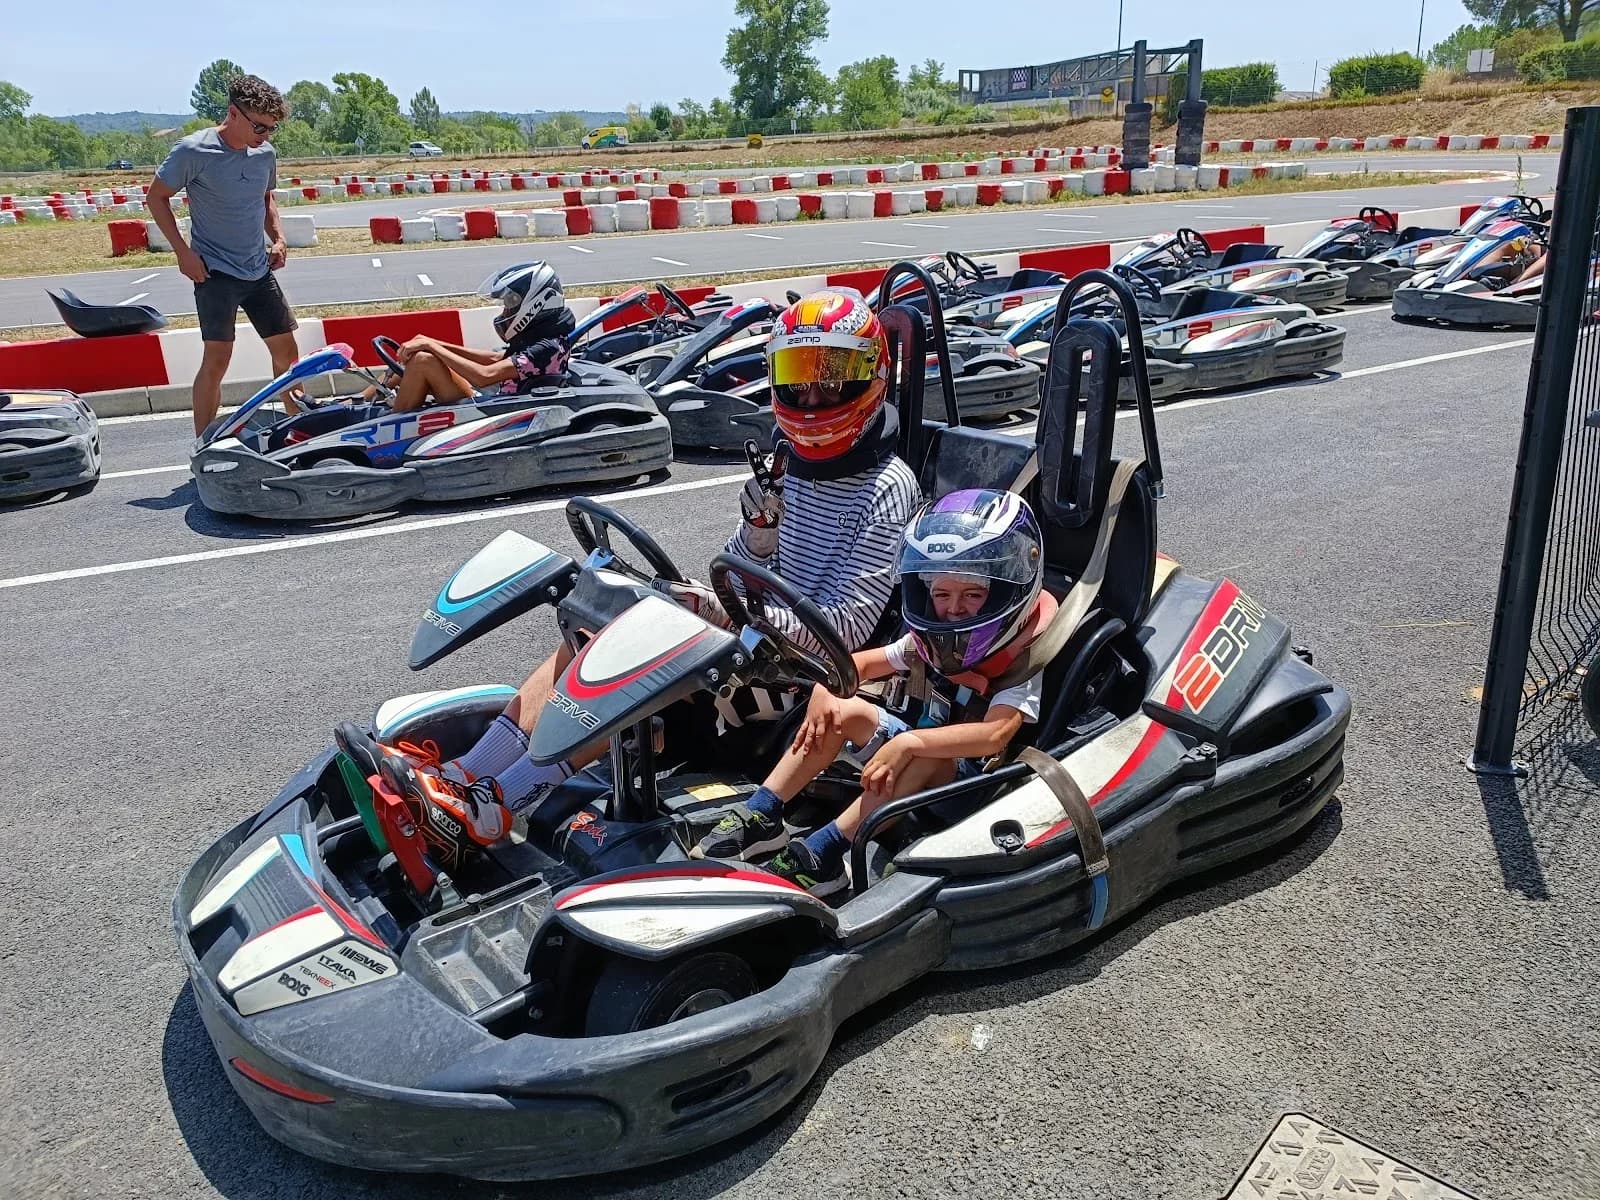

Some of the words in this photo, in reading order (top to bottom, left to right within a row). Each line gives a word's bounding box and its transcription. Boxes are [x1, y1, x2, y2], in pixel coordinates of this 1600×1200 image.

[340, 411, 456, 444] RT8
[1172, 588, 1266, 715] 2DRIV
[318, 954, 357, 981] ITAKA
